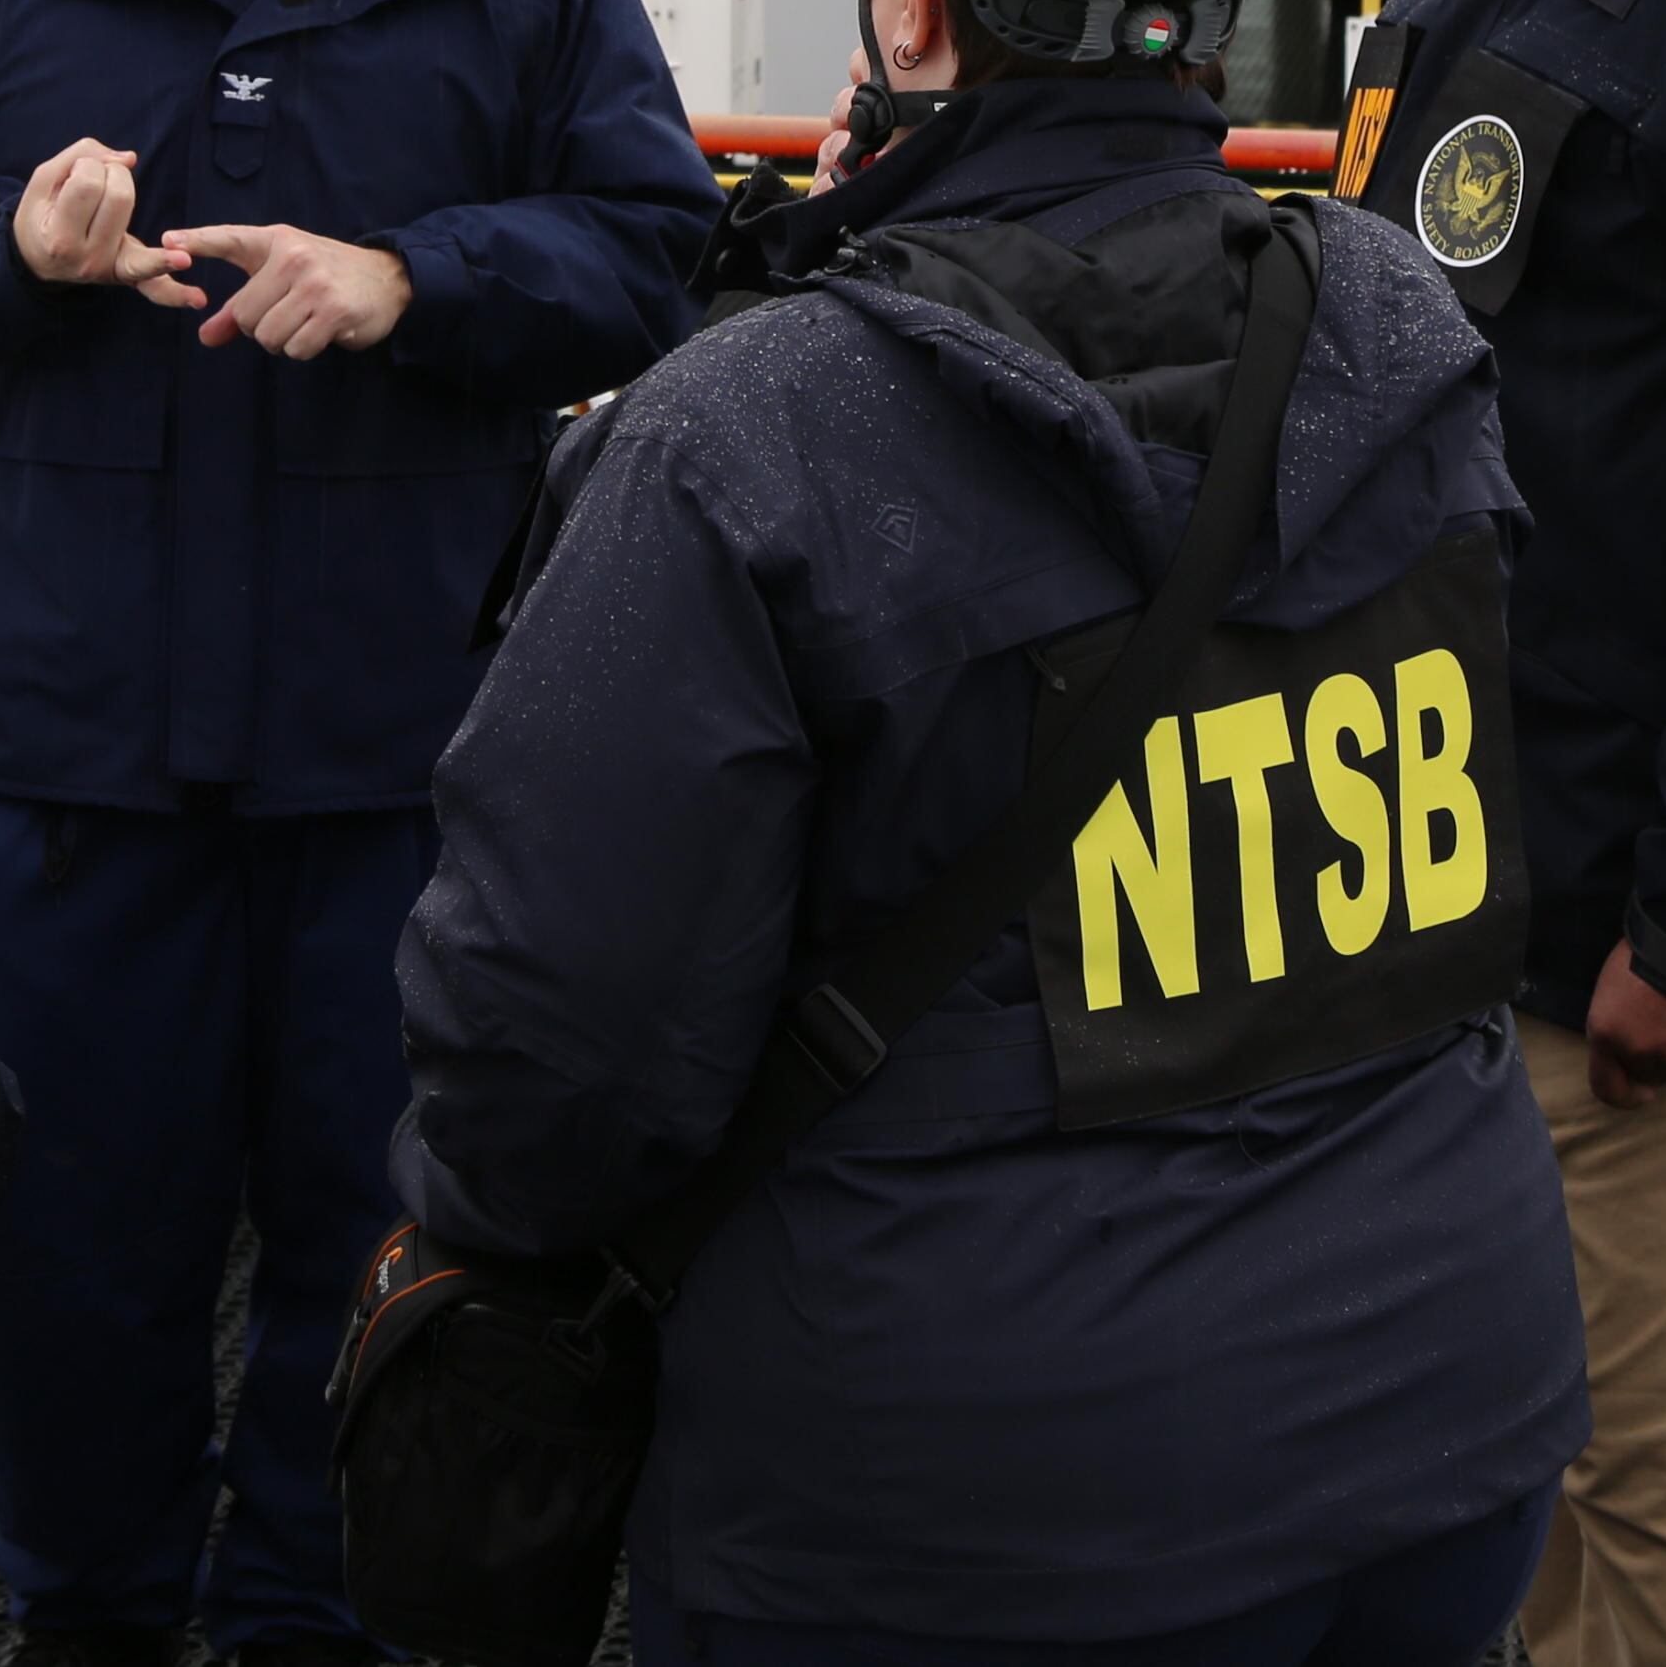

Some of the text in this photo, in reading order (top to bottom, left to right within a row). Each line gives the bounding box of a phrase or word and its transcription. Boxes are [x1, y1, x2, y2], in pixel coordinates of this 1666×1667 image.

[1423, 204, 1500, 259] SAFETY BOARD
[1424, 122, 1521, 234] NATIONAL TRANSPORTATION
[1072, 648, 1488, 1011] NTSB
